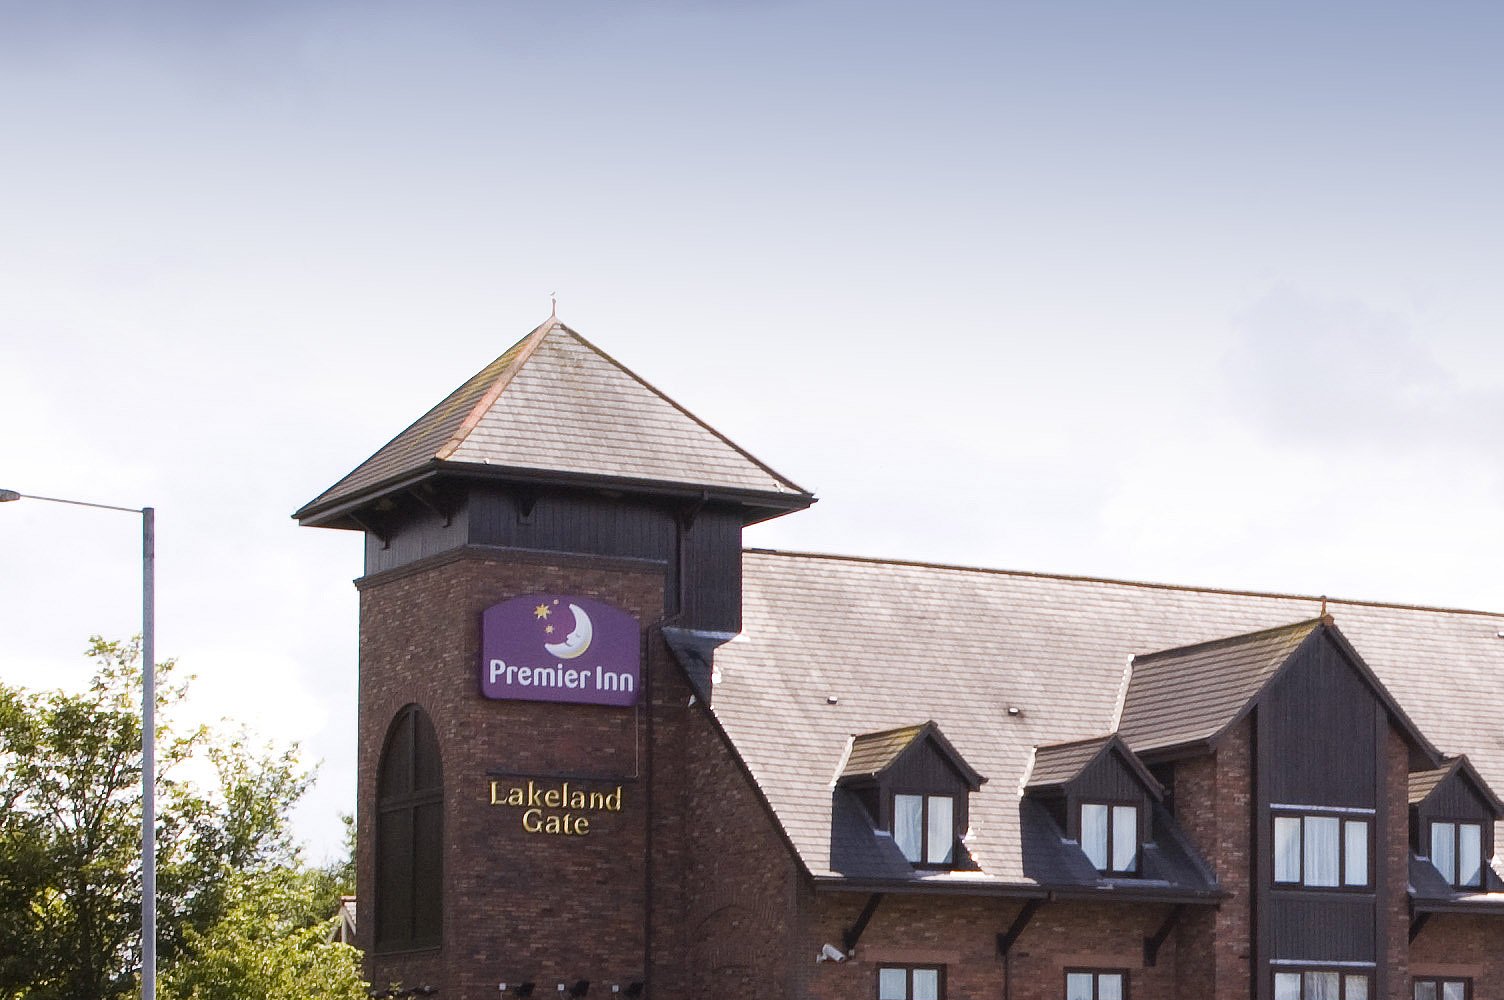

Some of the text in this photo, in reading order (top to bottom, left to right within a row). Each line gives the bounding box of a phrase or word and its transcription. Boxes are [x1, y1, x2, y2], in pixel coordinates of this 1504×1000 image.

[489, 659, 634, 692] Premier Inn
[489, 779, 623, 812] Lakeland
[521, 808, 591, 836] Gate
